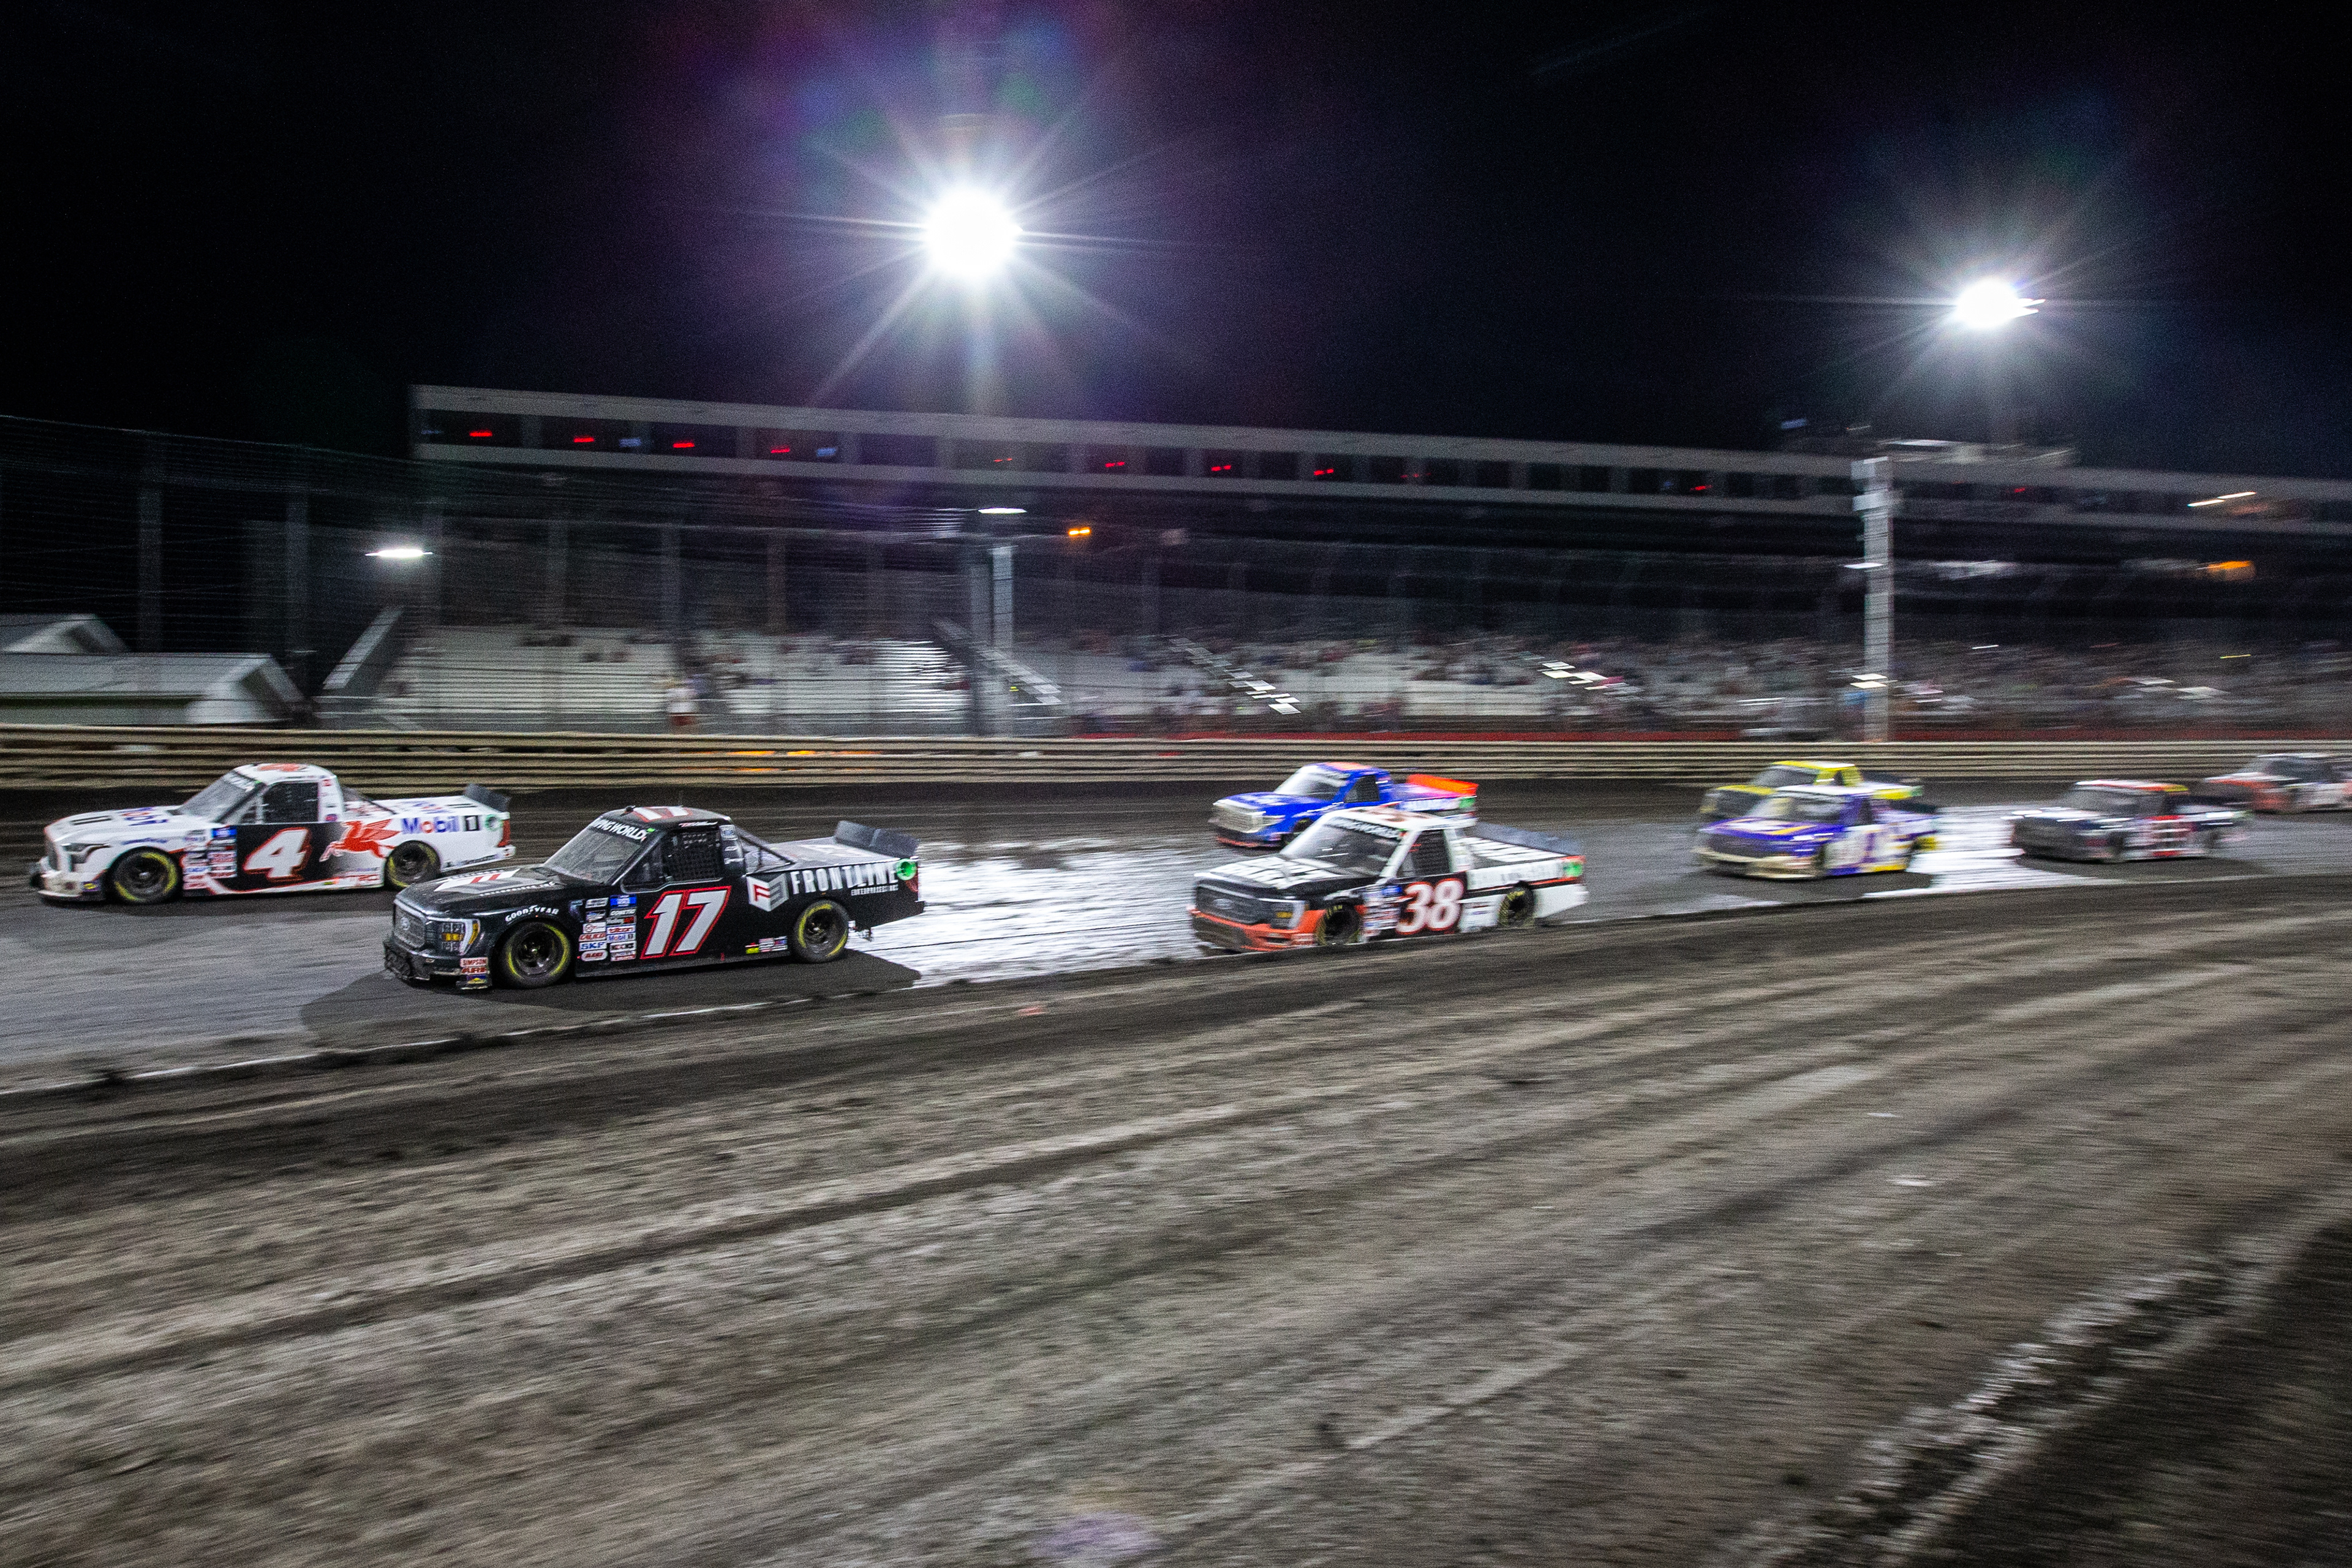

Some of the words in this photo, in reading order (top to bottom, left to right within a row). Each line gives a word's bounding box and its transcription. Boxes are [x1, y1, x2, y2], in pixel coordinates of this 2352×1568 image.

[401, 816, 459, 834] Mobil
[464, 815, 480, 832] 1
[609, 822, 647, 840] WORLD
[242, 827, 312, 882] 4
[790, 862, 899, 894] FRONTLINE
[505, 905, 559, 922] GOODYEAR
[1395, 878, 1464, 935] 38
[640, 885, 731, 959] 17
[581, 941, 605, 950] SKF
